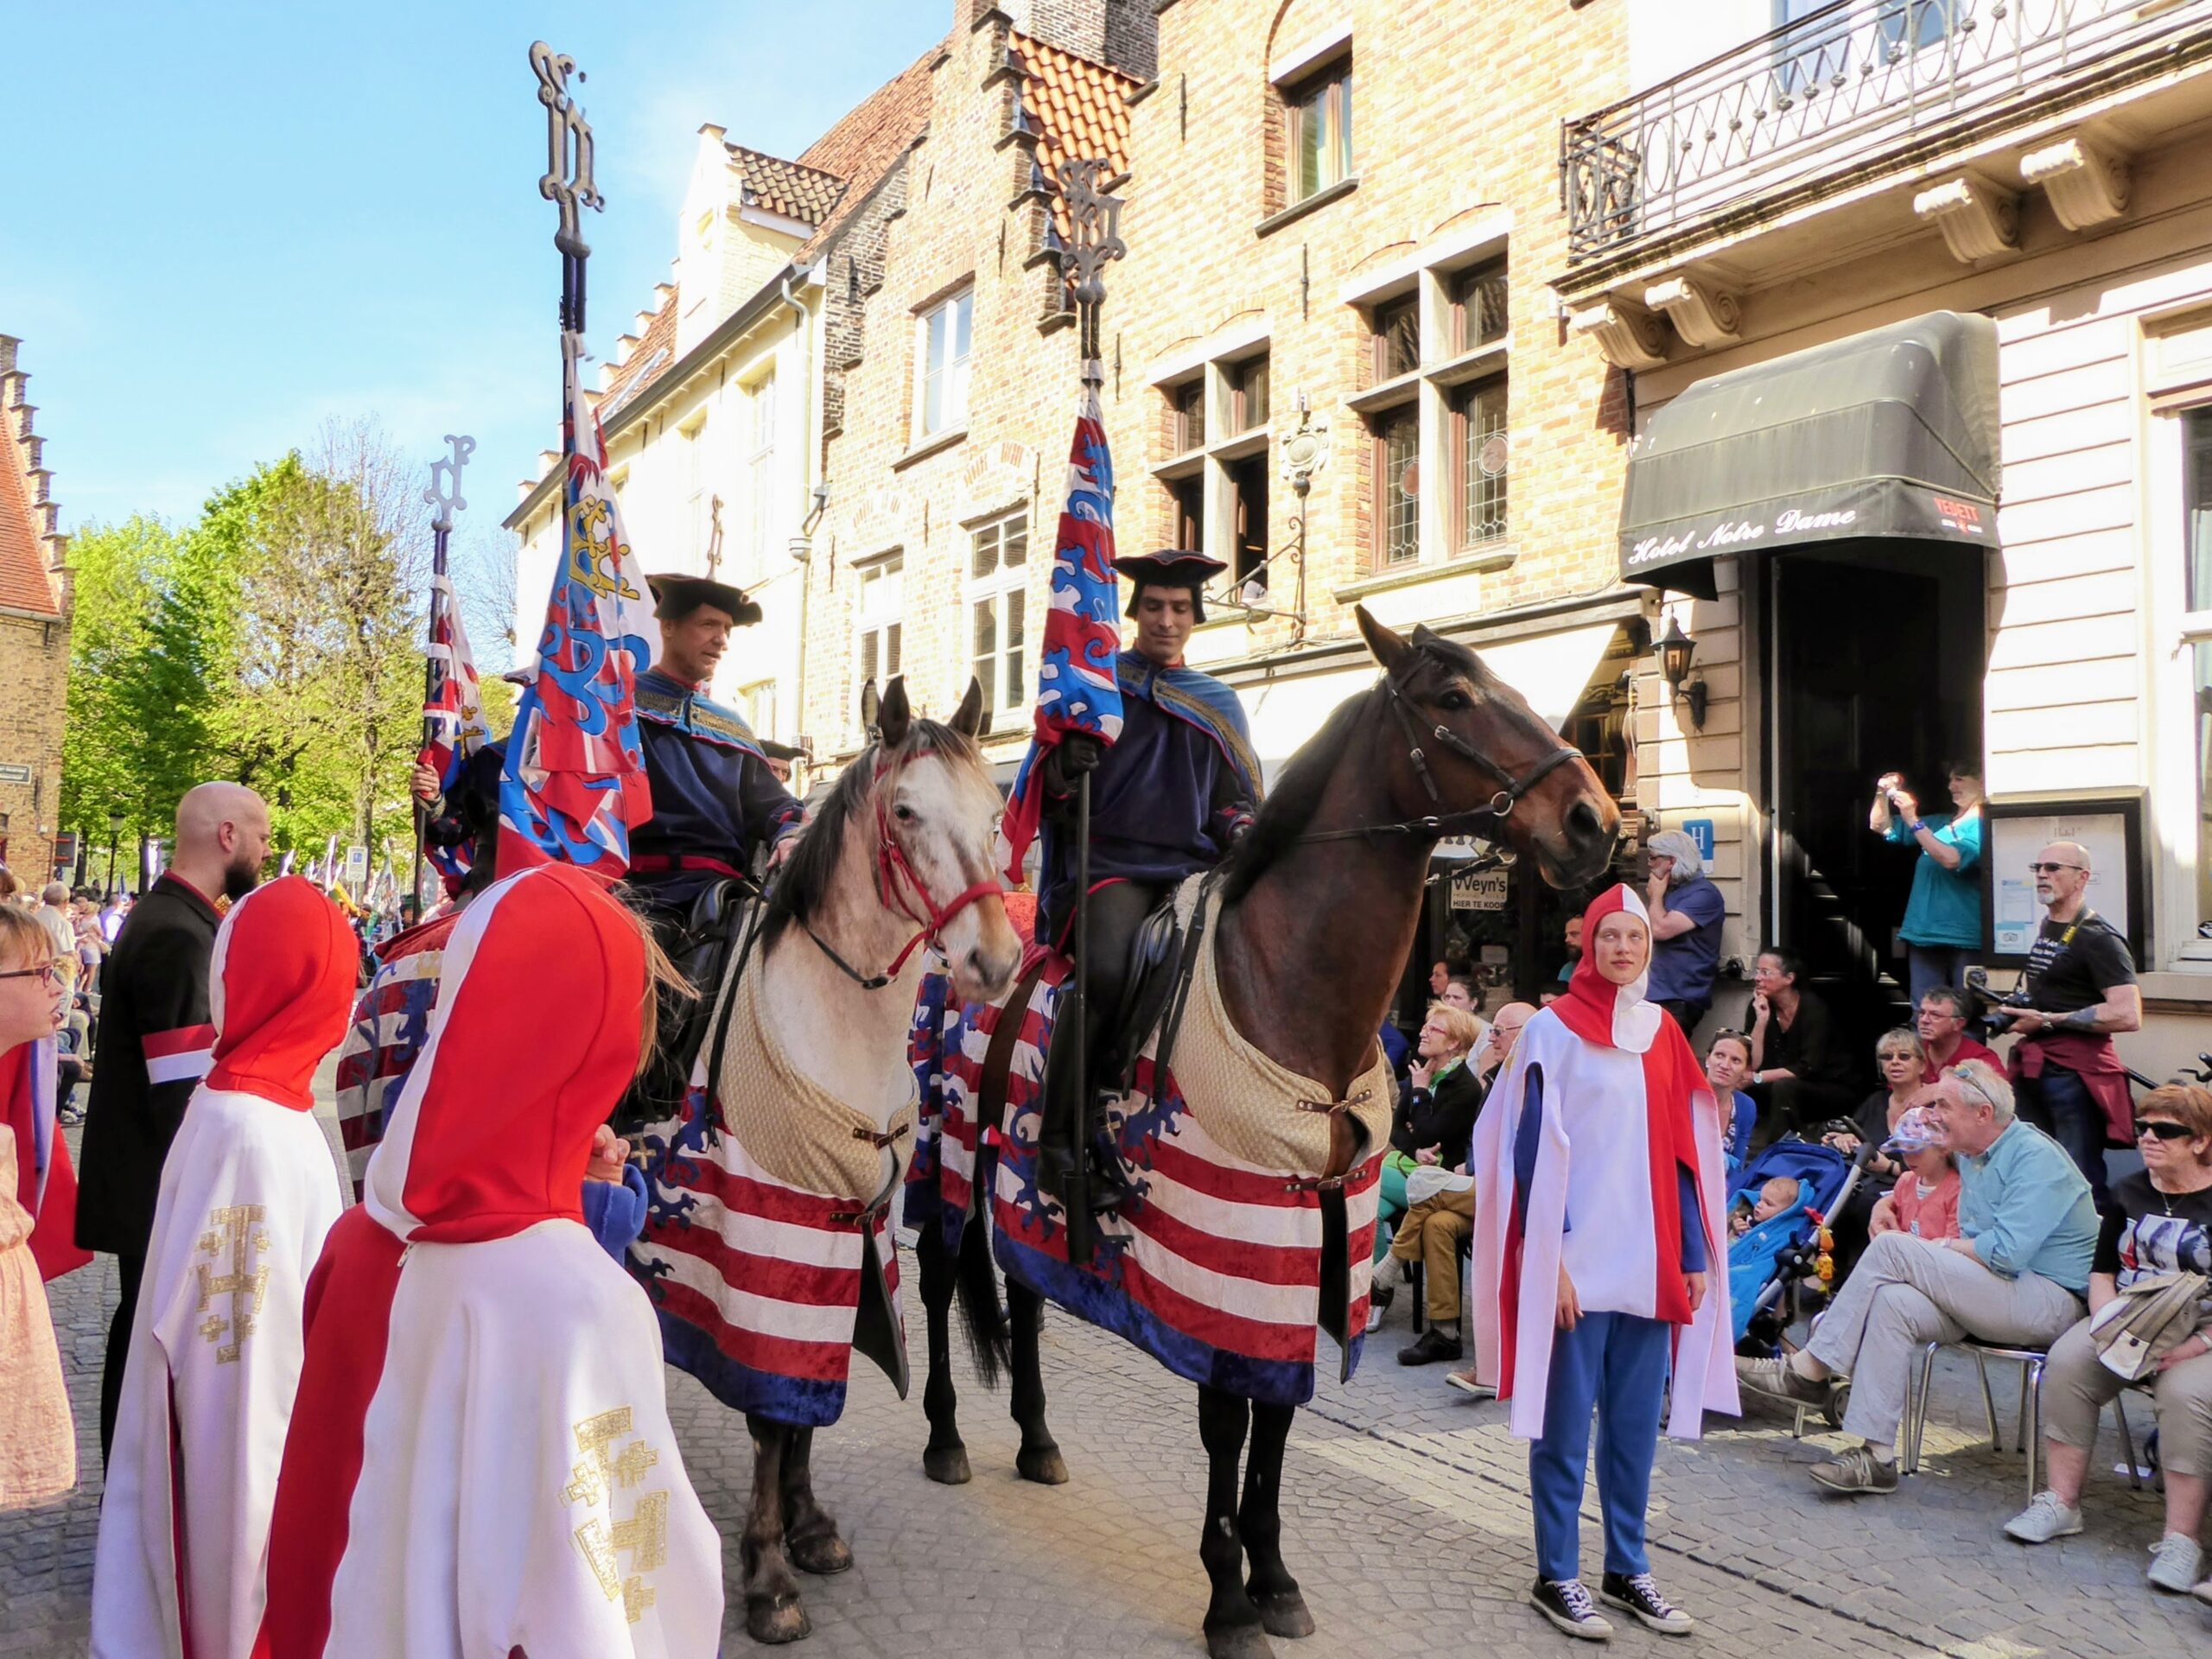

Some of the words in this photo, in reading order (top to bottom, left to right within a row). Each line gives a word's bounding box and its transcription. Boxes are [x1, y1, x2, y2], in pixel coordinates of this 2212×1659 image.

[1628, 530, 1695, 565] Hotel
[1697, 521, 1765, 550] Notre
[1774, 509, 1857, 534] Dame
[1691, 826, 1705, 850] H
[1452, 875, 1506, 894] Weyn's
